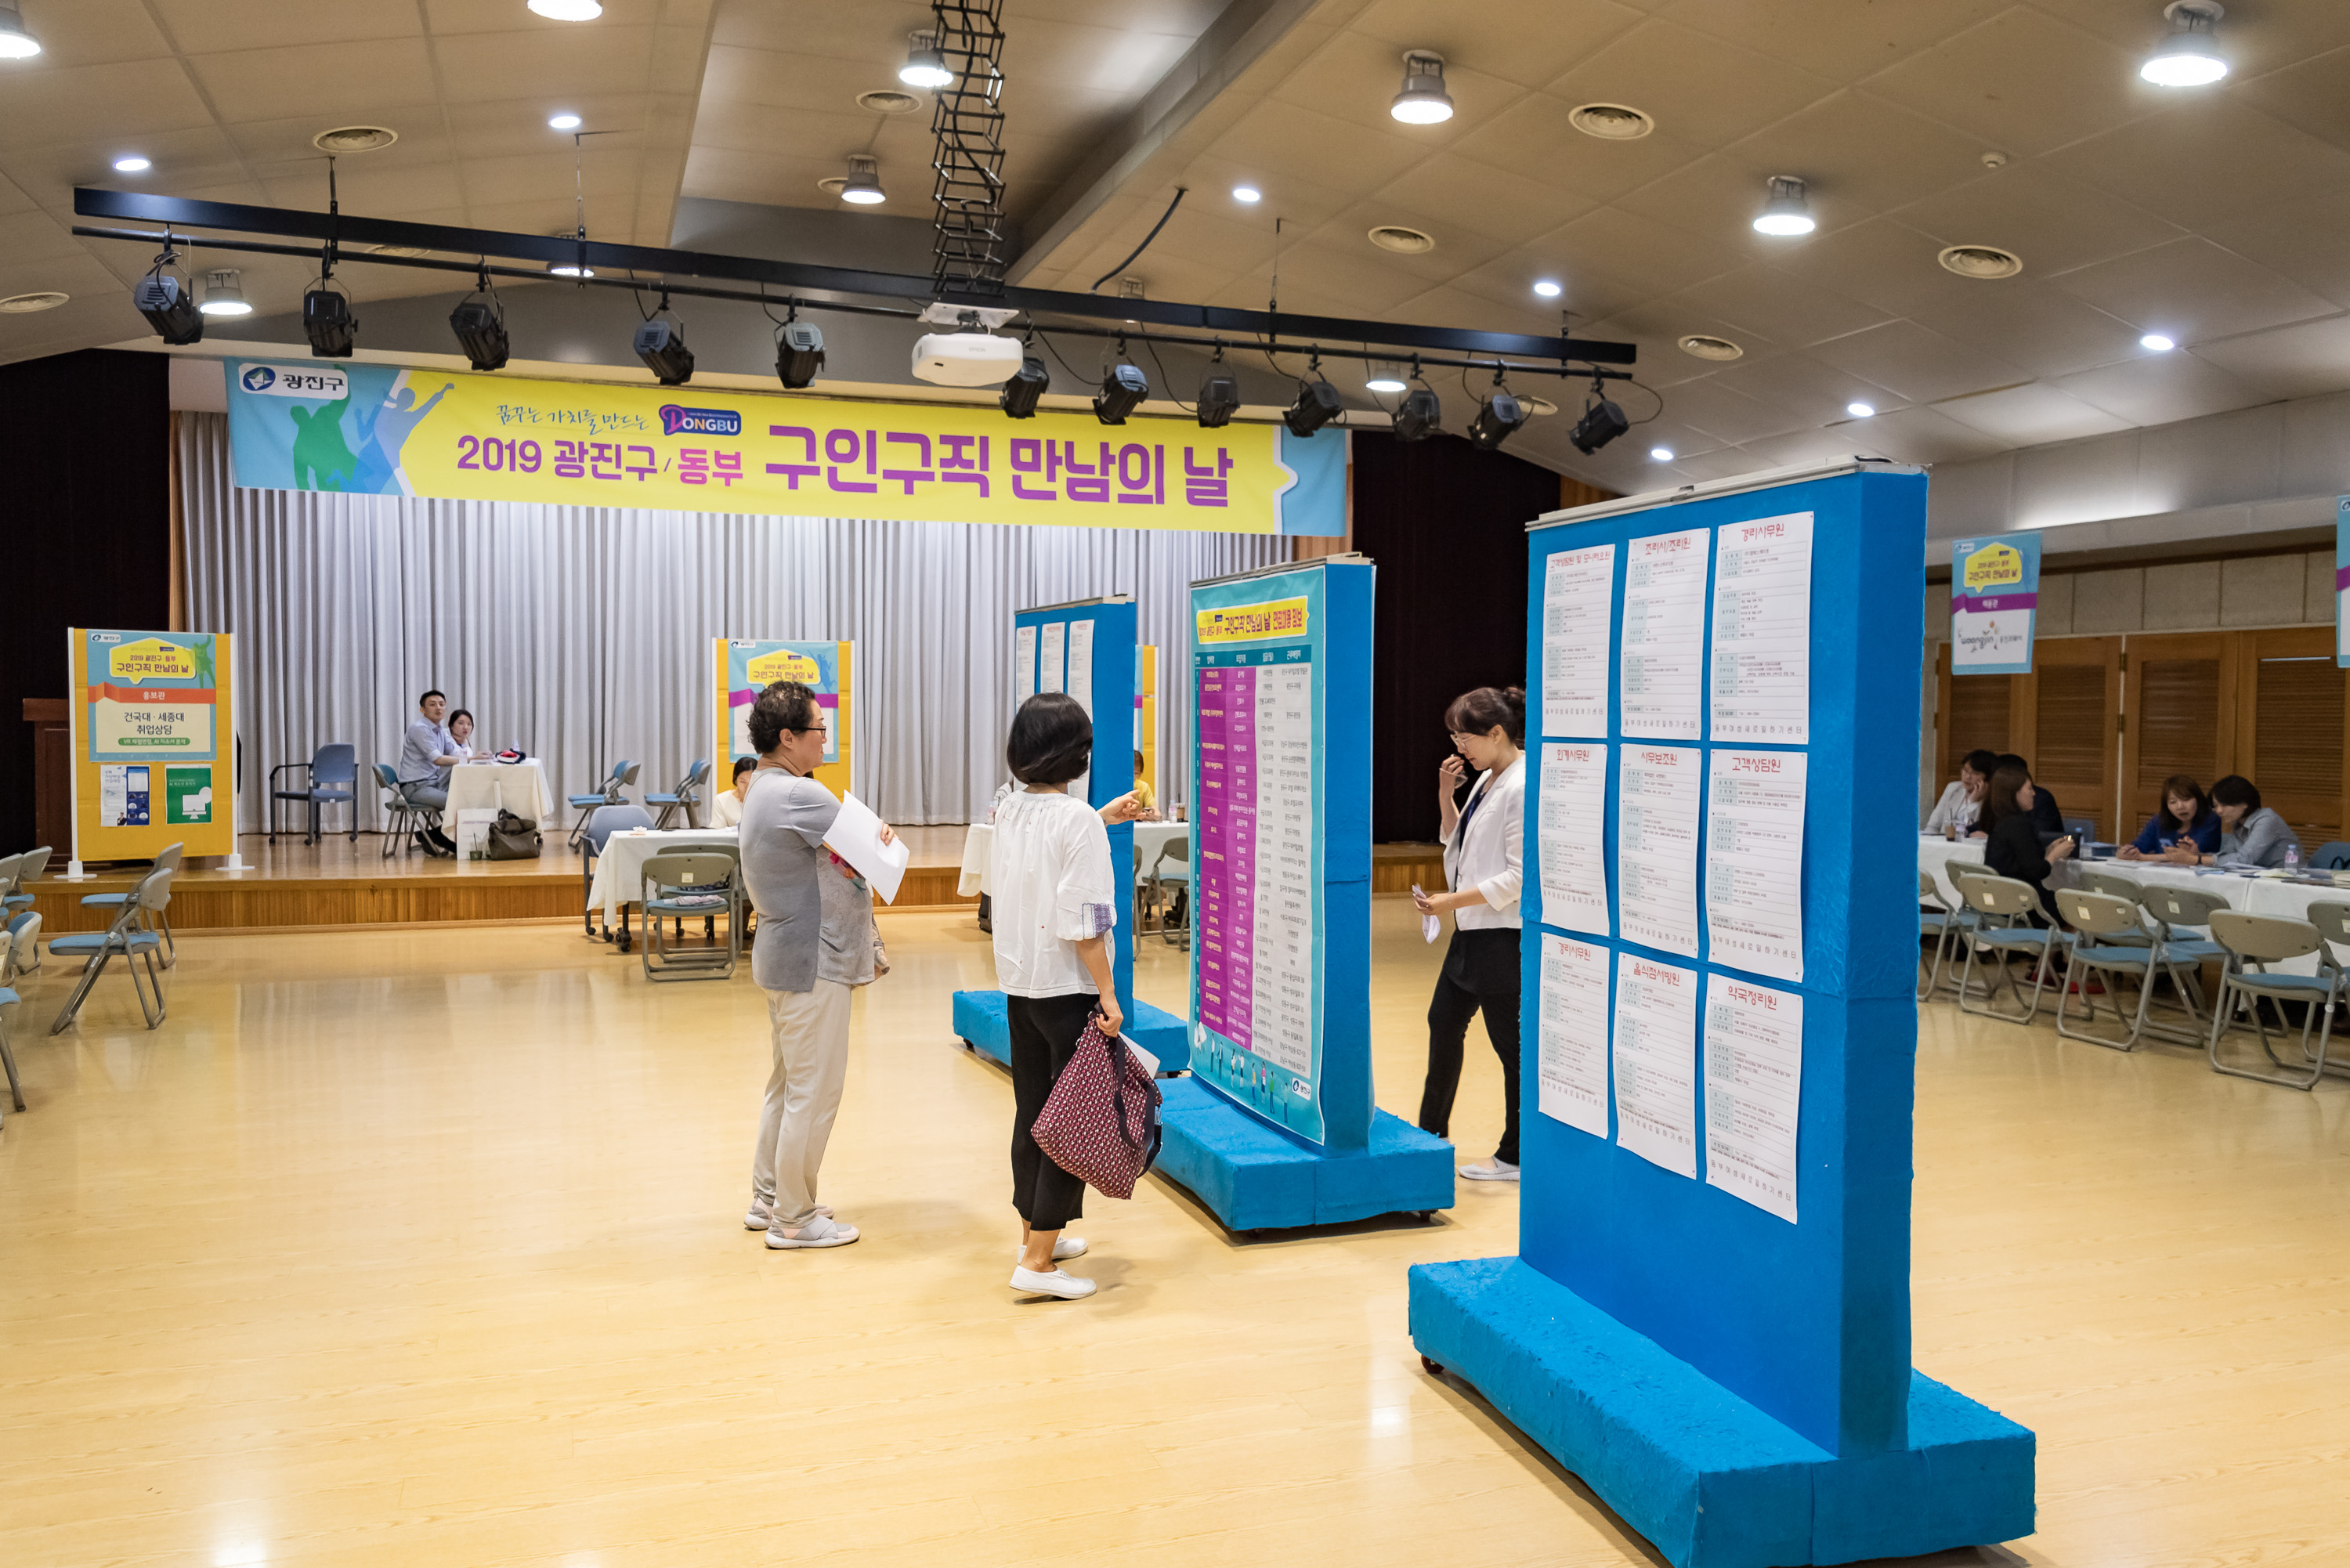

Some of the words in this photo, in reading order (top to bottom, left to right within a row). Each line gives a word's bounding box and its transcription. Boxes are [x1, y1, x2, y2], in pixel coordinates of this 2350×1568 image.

[282, 374, 345, 392] 광진구
[496, 404, 543, 425] 꿈꾸는
[547, 408, 603, 436] 가치를
[602, 413, 649, 431] 만드는
[660, 406, 738, 434] DONGBU
[457, 435, 542, 473] 2019
[766, 425, 990, 498] 구인구직
[1010, 438, 1166, 505] 만남의
[1184, 446, 1234, 508] 날
[1741, 523, 1784, 542] 경리사무원
[117, 663, 152, 673] 구인구직
[154, 663, 179, 673] 만남의
[181, 664, 189, 673] 날
[124, 712, 151, 722] 건국대
[157, 712, 185, 723] 세종대
[136, 724, 172, 735] 취업상담
[1640, 752, 1678, 766] 사무보조원
[1732, 757, 1781, 773] 고객상담원
[1558, 941, 1591, 962] 경리사무원
[1633, 963, 1680, 987] 음식점서빙원
[1728, 985, 1777, 1010] 약국정리원
